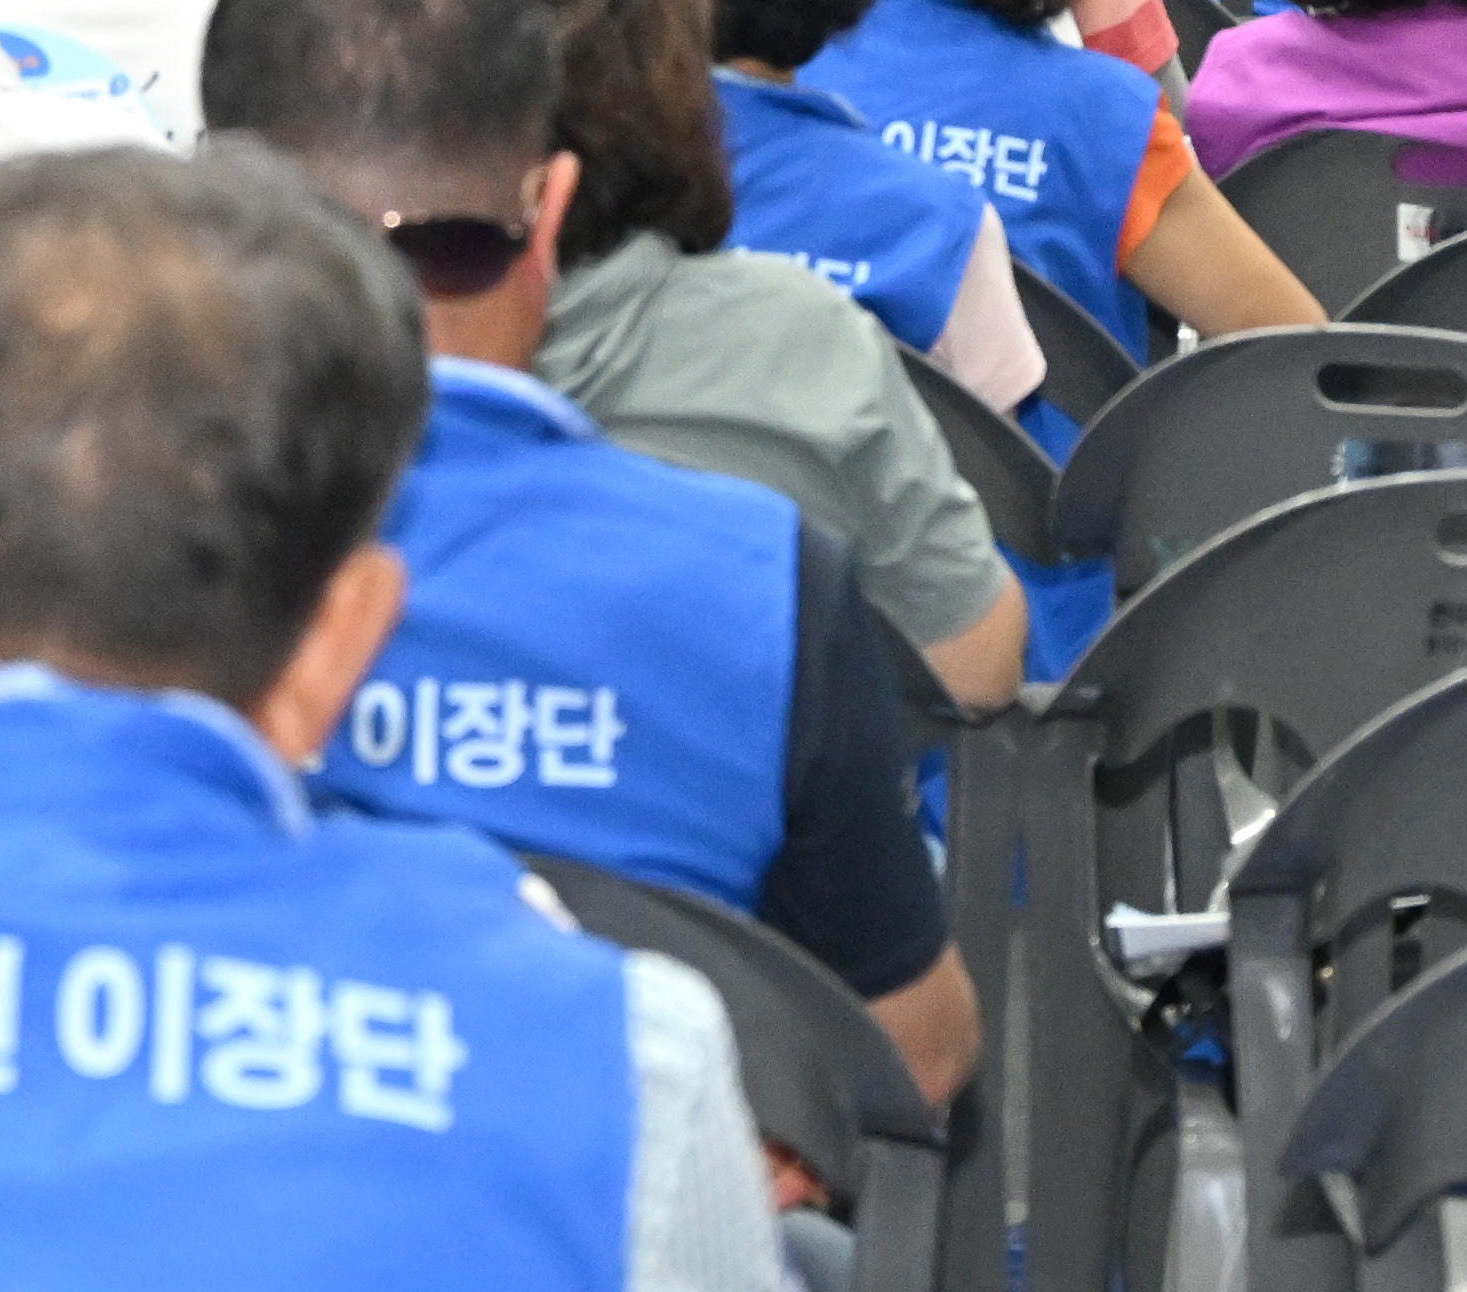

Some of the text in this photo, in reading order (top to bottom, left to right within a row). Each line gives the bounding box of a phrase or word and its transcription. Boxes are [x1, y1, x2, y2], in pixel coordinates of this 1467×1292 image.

[880, 120, 1048, 202] 이장단
[352, 675, 625, 789] 이장단
[54, 942, 470, 1135] 이장단
